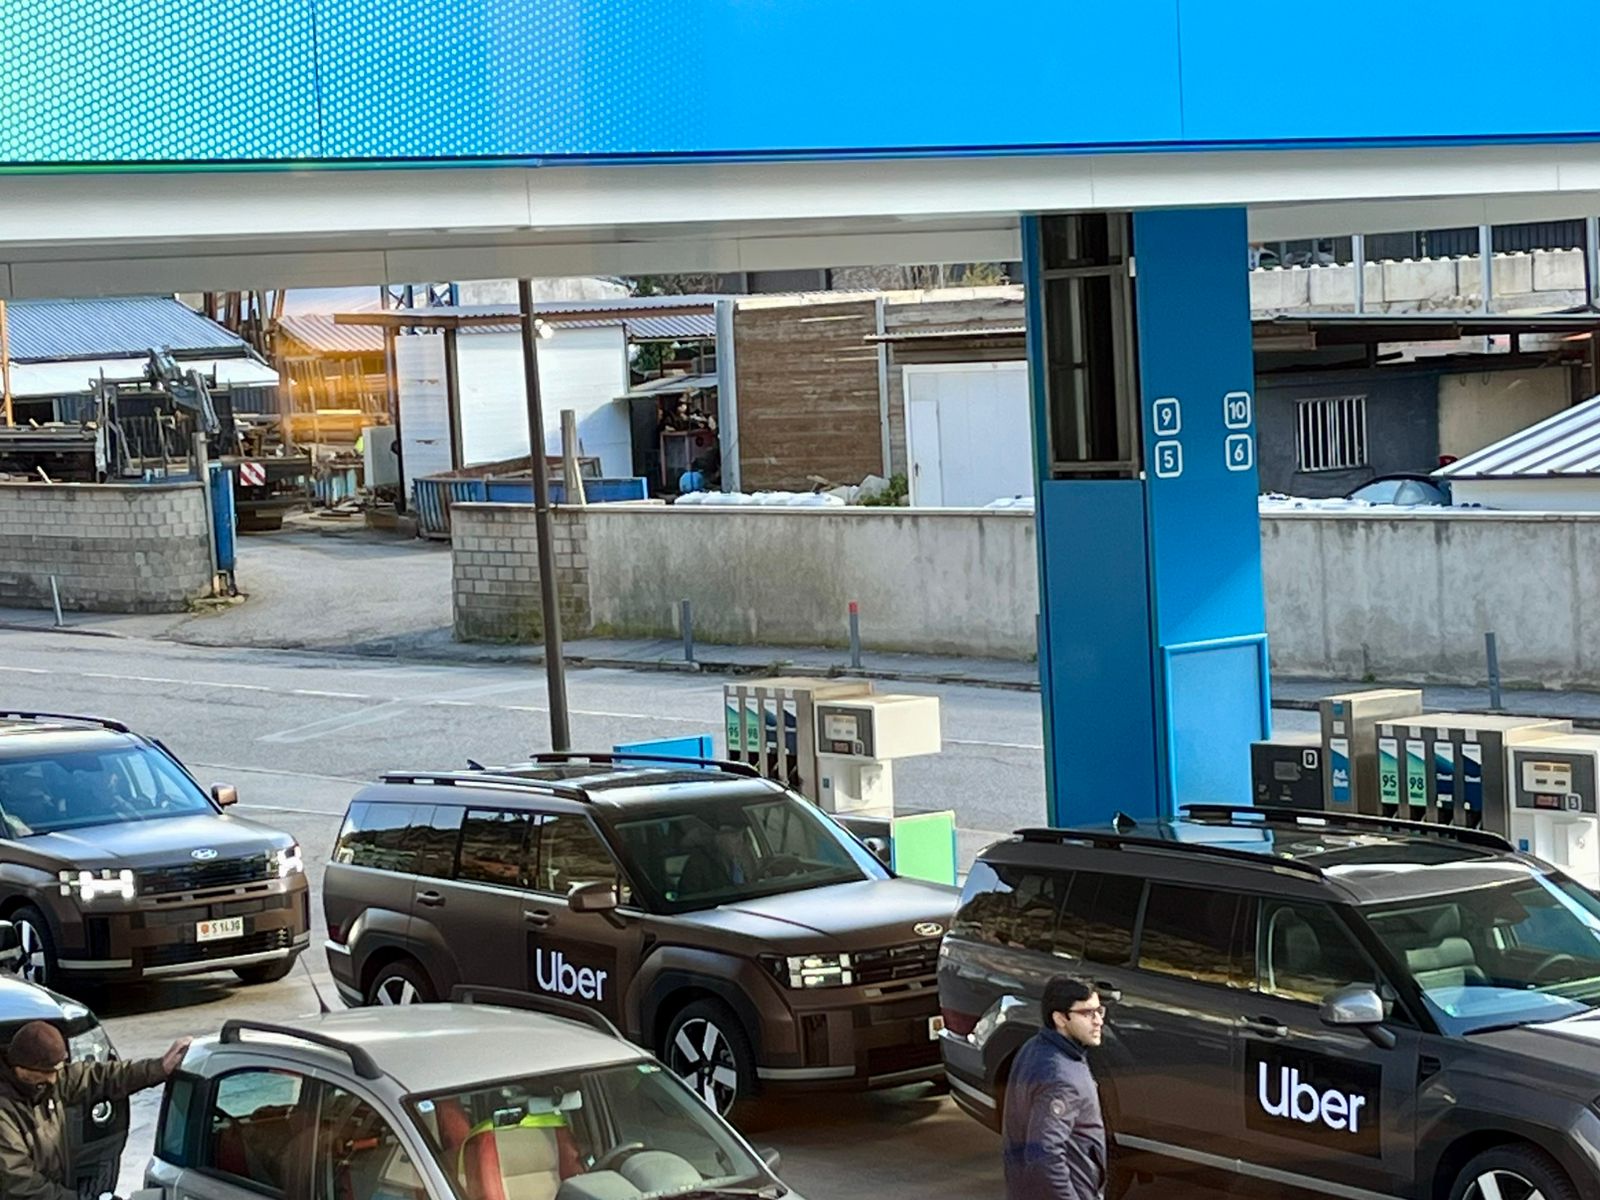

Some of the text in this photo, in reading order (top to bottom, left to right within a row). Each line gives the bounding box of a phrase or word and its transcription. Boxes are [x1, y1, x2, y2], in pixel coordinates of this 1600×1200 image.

[1161, 408, 1172, 426] 9
[1229, 401, 1246, 420] 10
[1164, 450, 1174, 469] 5
[1234, 443, 1244, 461] 6
[1382, 775, 1397, 788] 95
[1409, 777, 1425, 790] 98
[536, 948, 608, 1001] Uber
[1259, 1061, 1366, 1133] Uber
